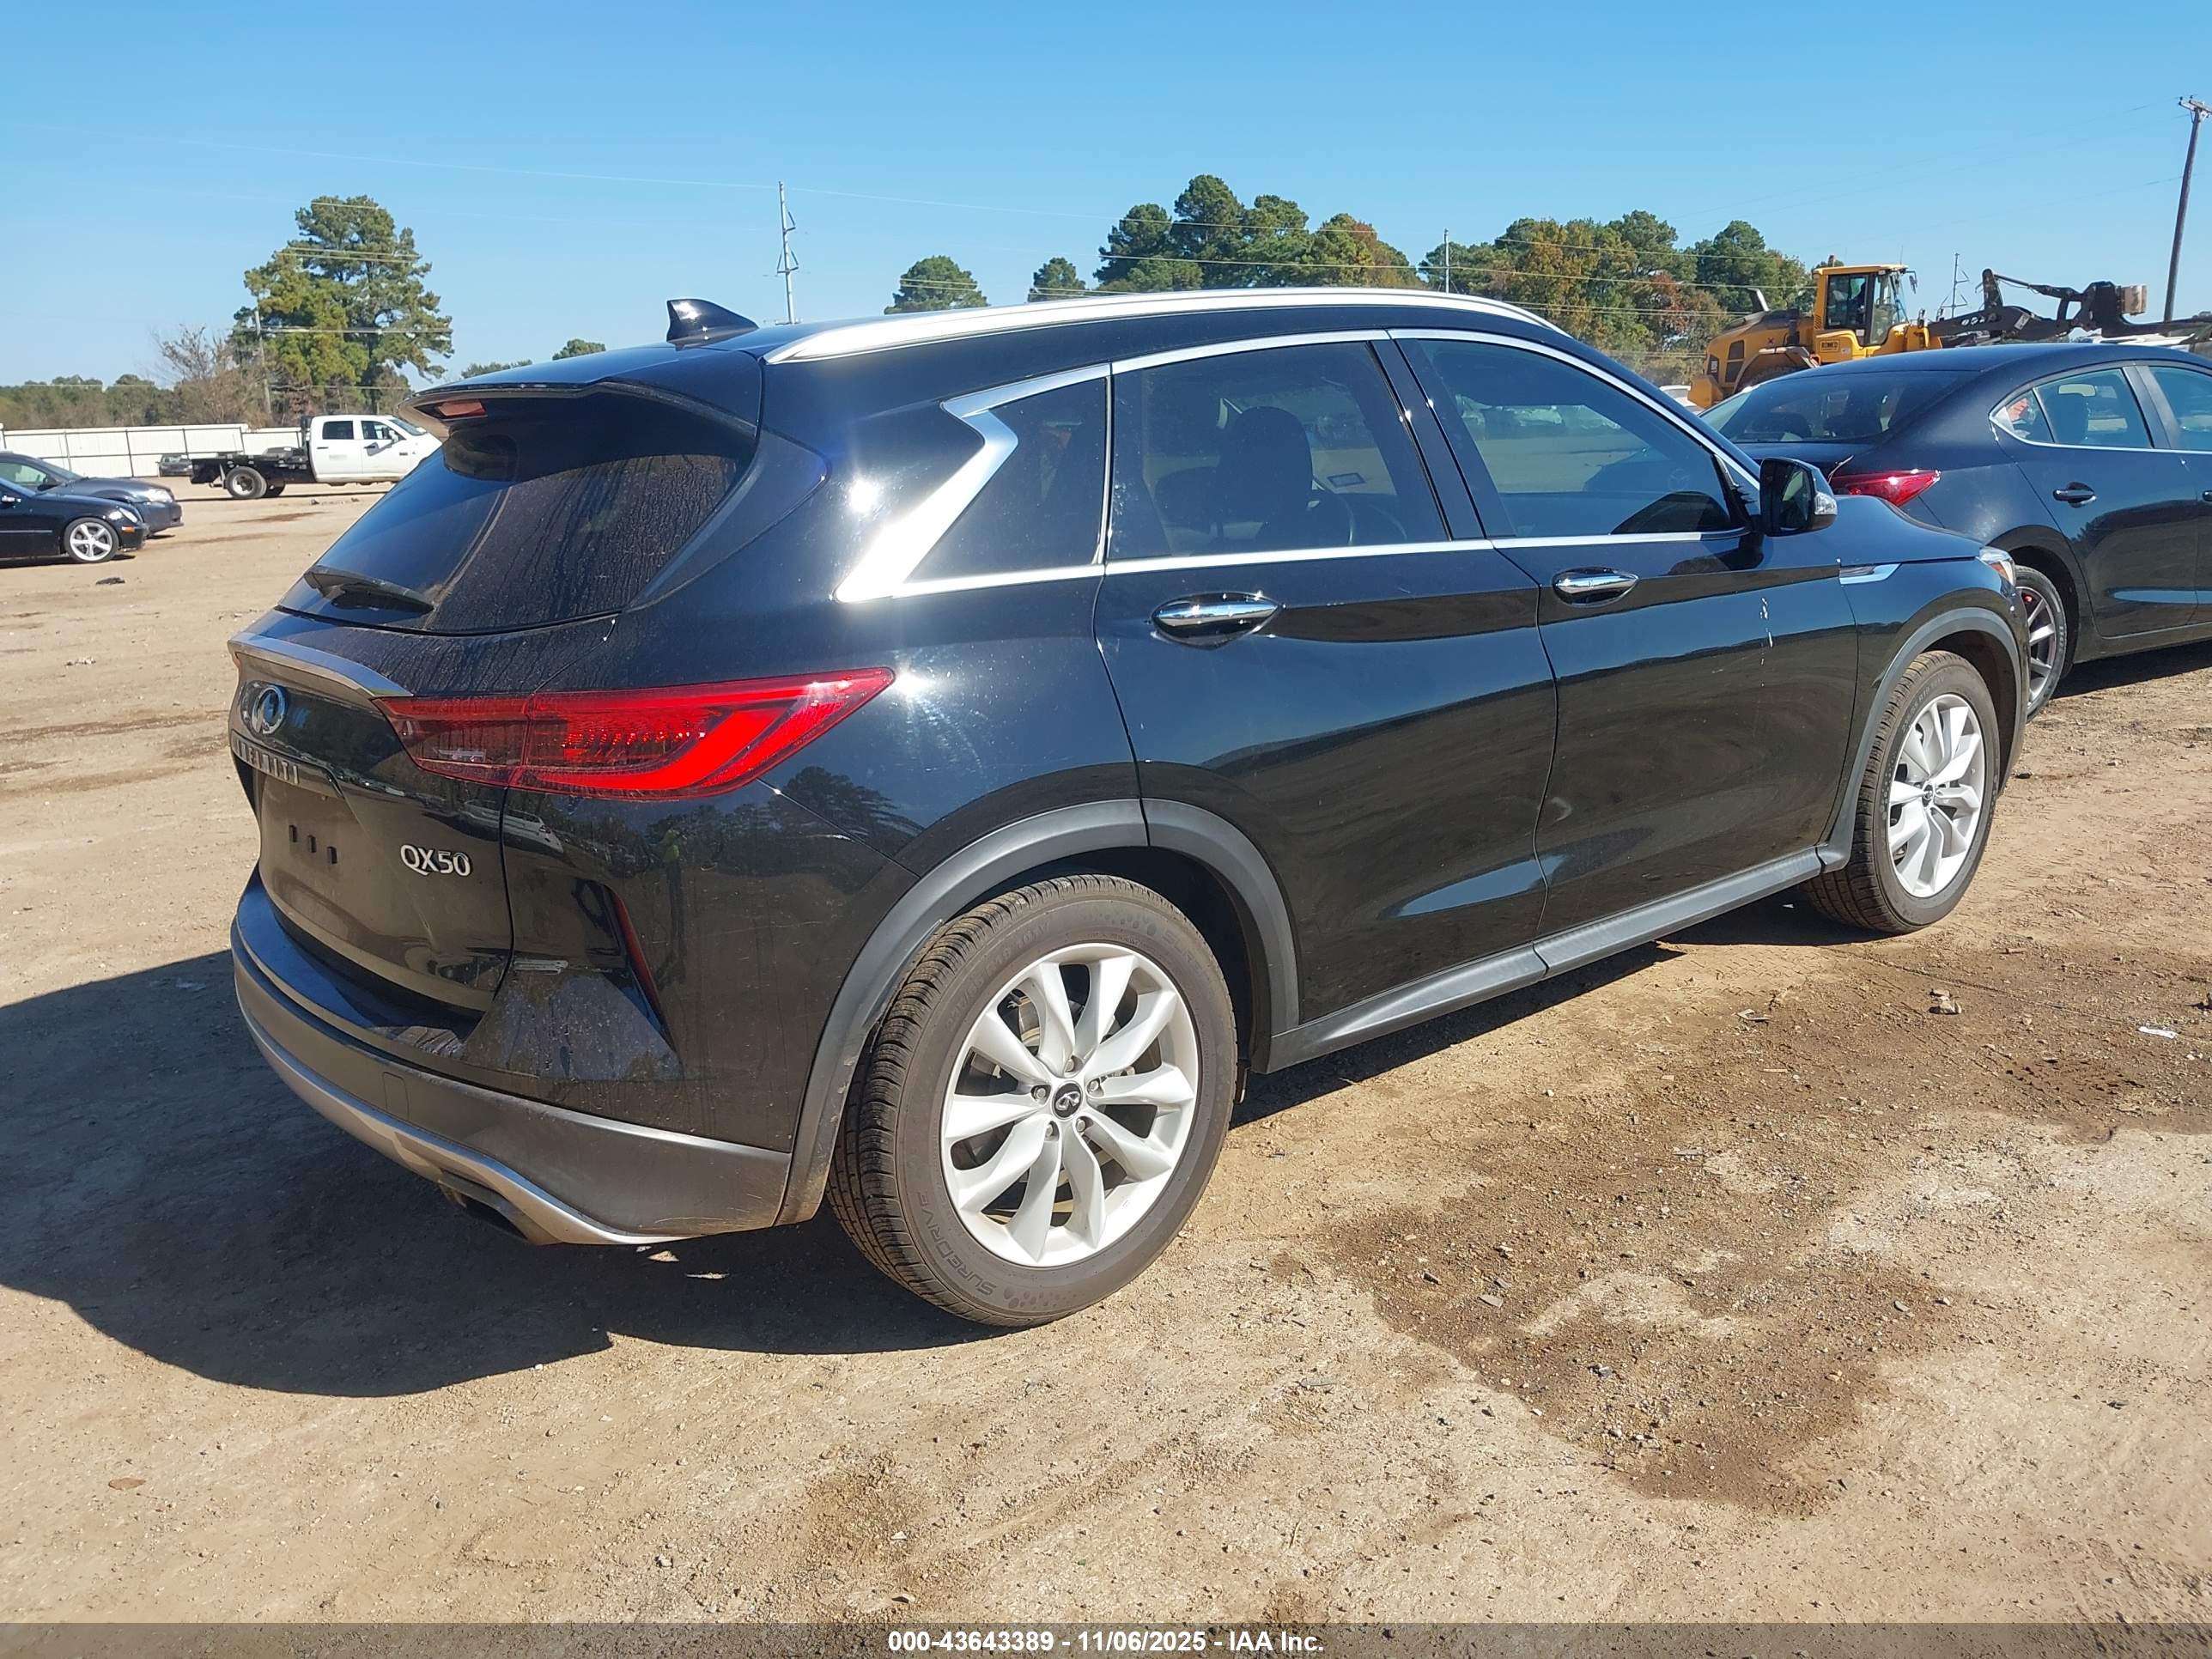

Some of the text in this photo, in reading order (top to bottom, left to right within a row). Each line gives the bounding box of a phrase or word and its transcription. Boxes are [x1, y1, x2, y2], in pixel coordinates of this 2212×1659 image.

[234, 738, 300, 785] INFINITI
[400, 843, 472, 877] QX50
[917, 1191, 997, 1296] SUREDRIVE
